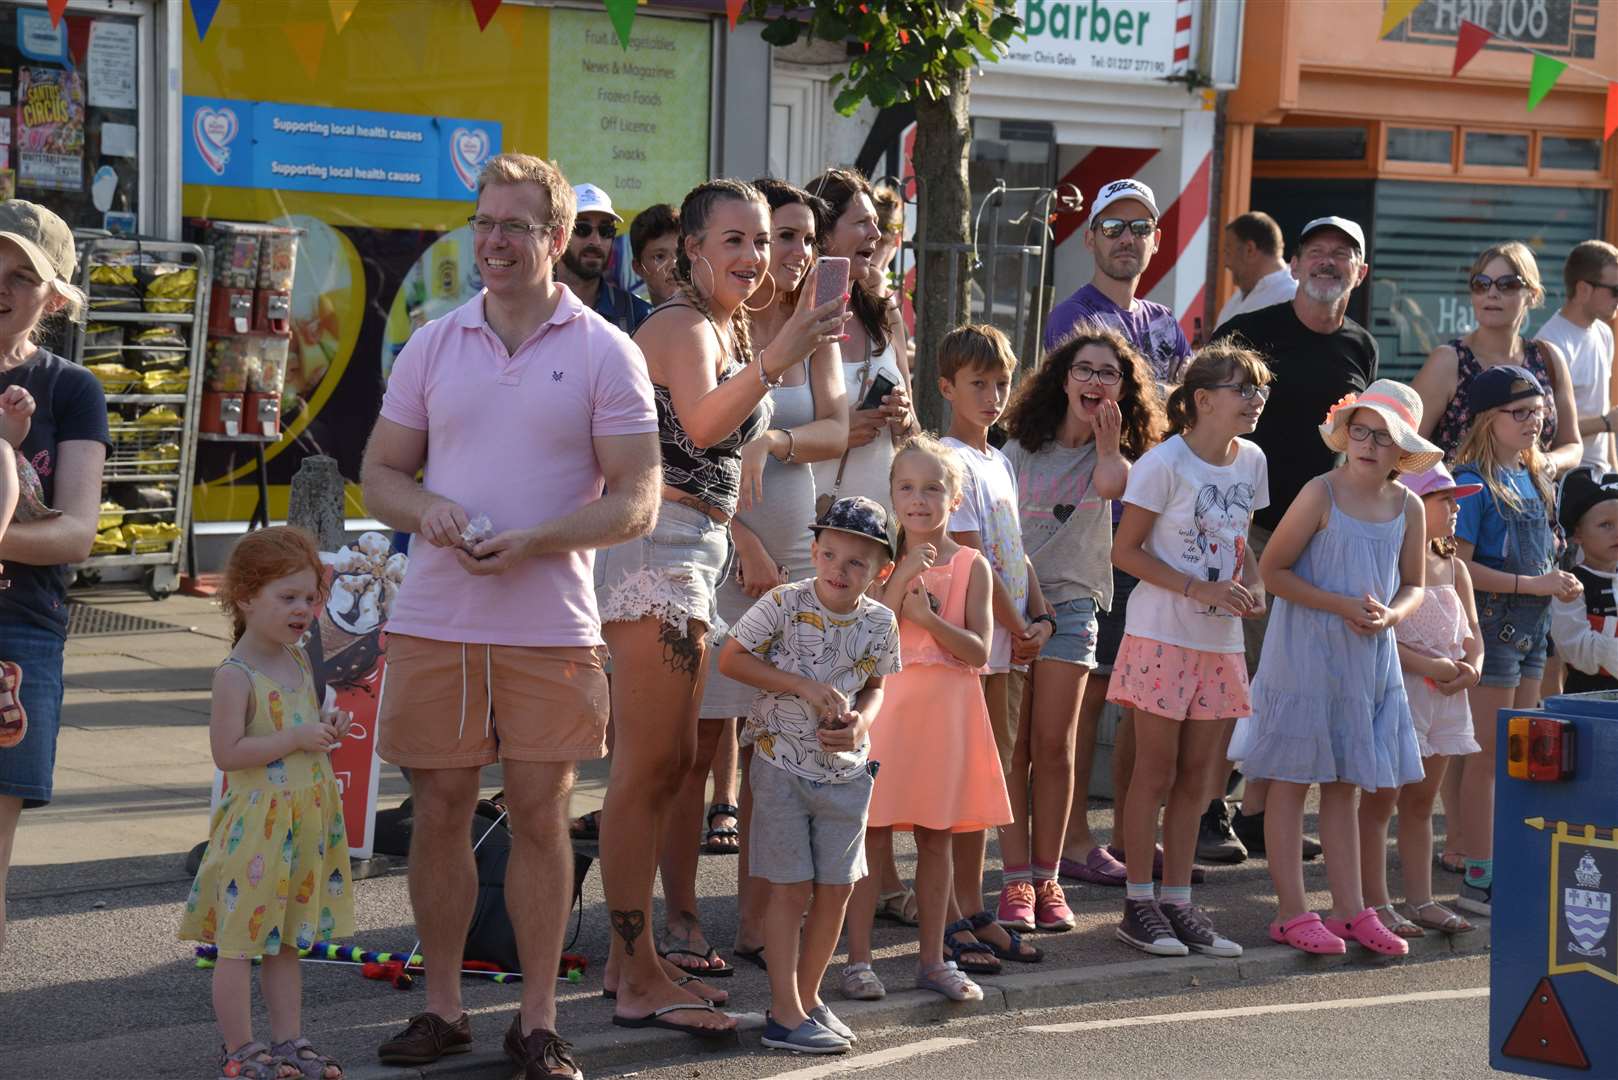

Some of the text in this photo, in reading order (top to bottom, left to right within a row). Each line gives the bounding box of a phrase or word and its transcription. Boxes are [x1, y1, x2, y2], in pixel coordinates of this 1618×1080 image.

[1024, 0, 1150, 46] Barber
[1435, 0, 1548, 39] Hair 108
[627, 35, 677, 52] egetables
[581, 58, 676, 80] News & Magazines
[598, 87, 662, 107] Frozen Foods
[23, 99, 69, 128] CIRCUS
[273, 117, 423, 142] Supporting local health causes
[601, 116, 657, 134] Off Licence
[612, 145, 647, 161] Snacks
[271, 160, 421, 184] Supporting local health causes
[615, 176, 642, 189] Lotto
